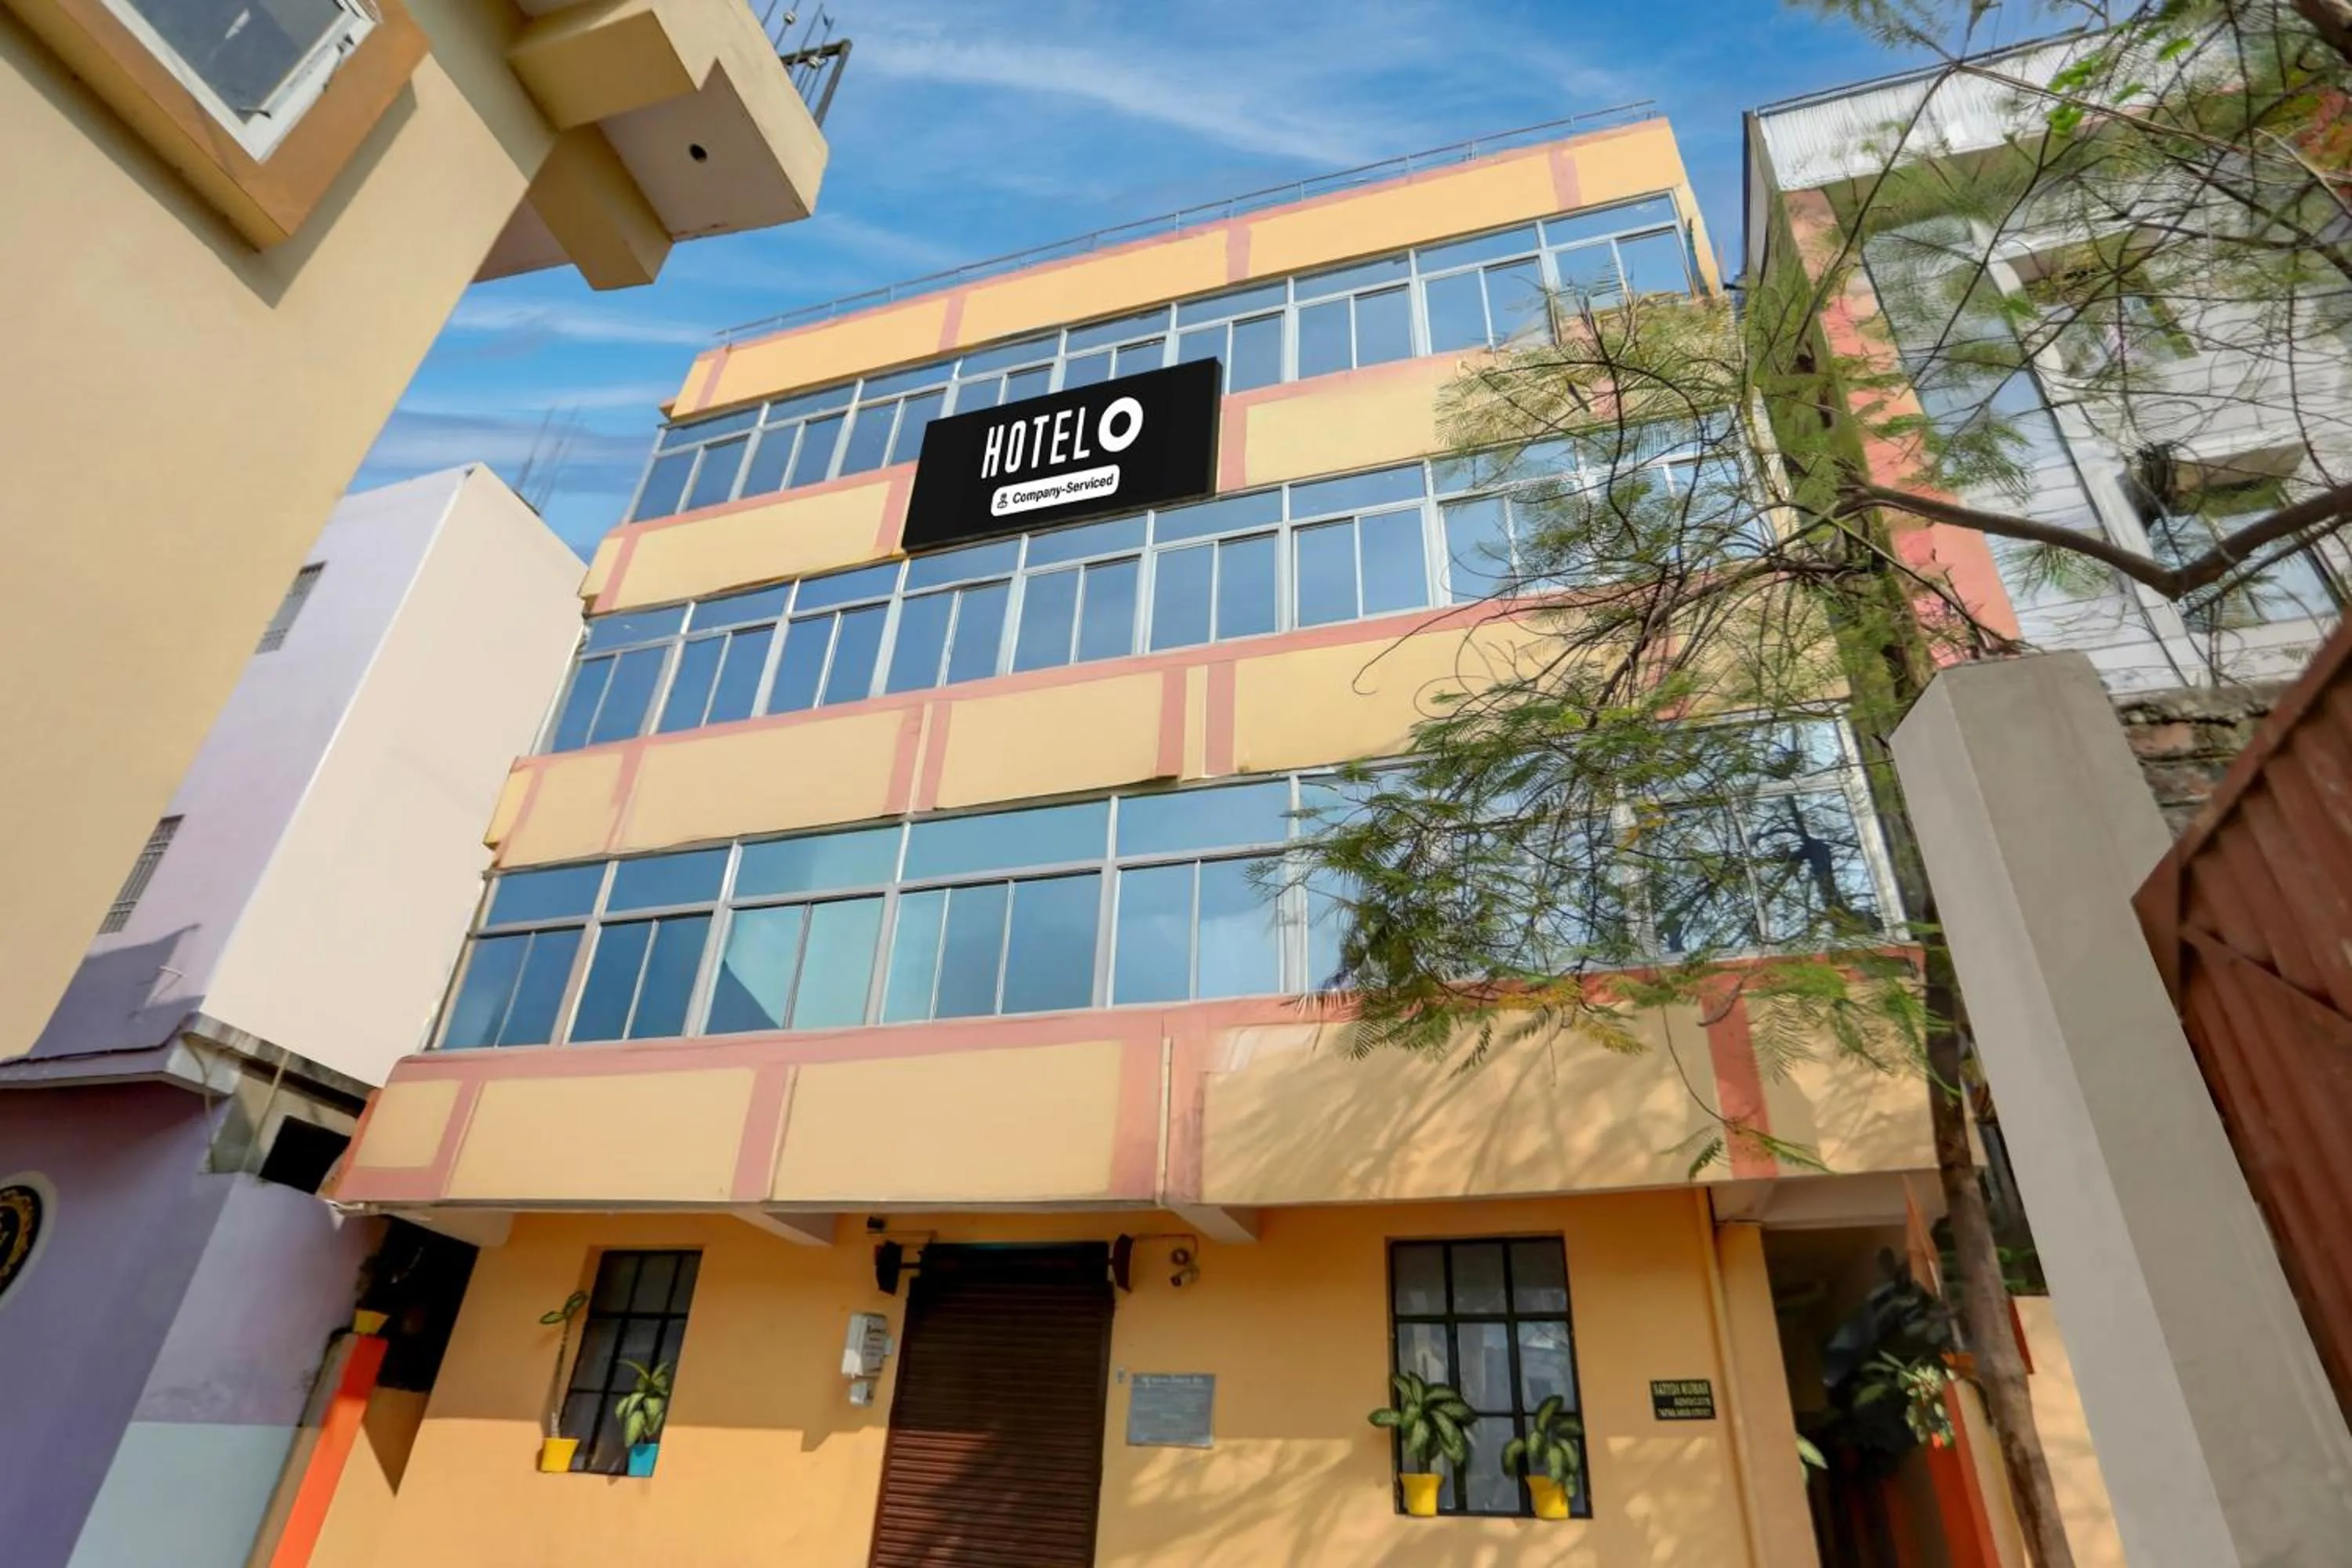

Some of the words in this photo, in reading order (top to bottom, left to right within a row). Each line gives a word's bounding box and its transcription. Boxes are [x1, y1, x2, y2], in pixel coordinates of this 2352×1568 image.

[982, 407, 1091, 479] HOTEL
[1098, 397, 1143, 452] O
[1012, 473, 1114, 504] Company-Serviced
